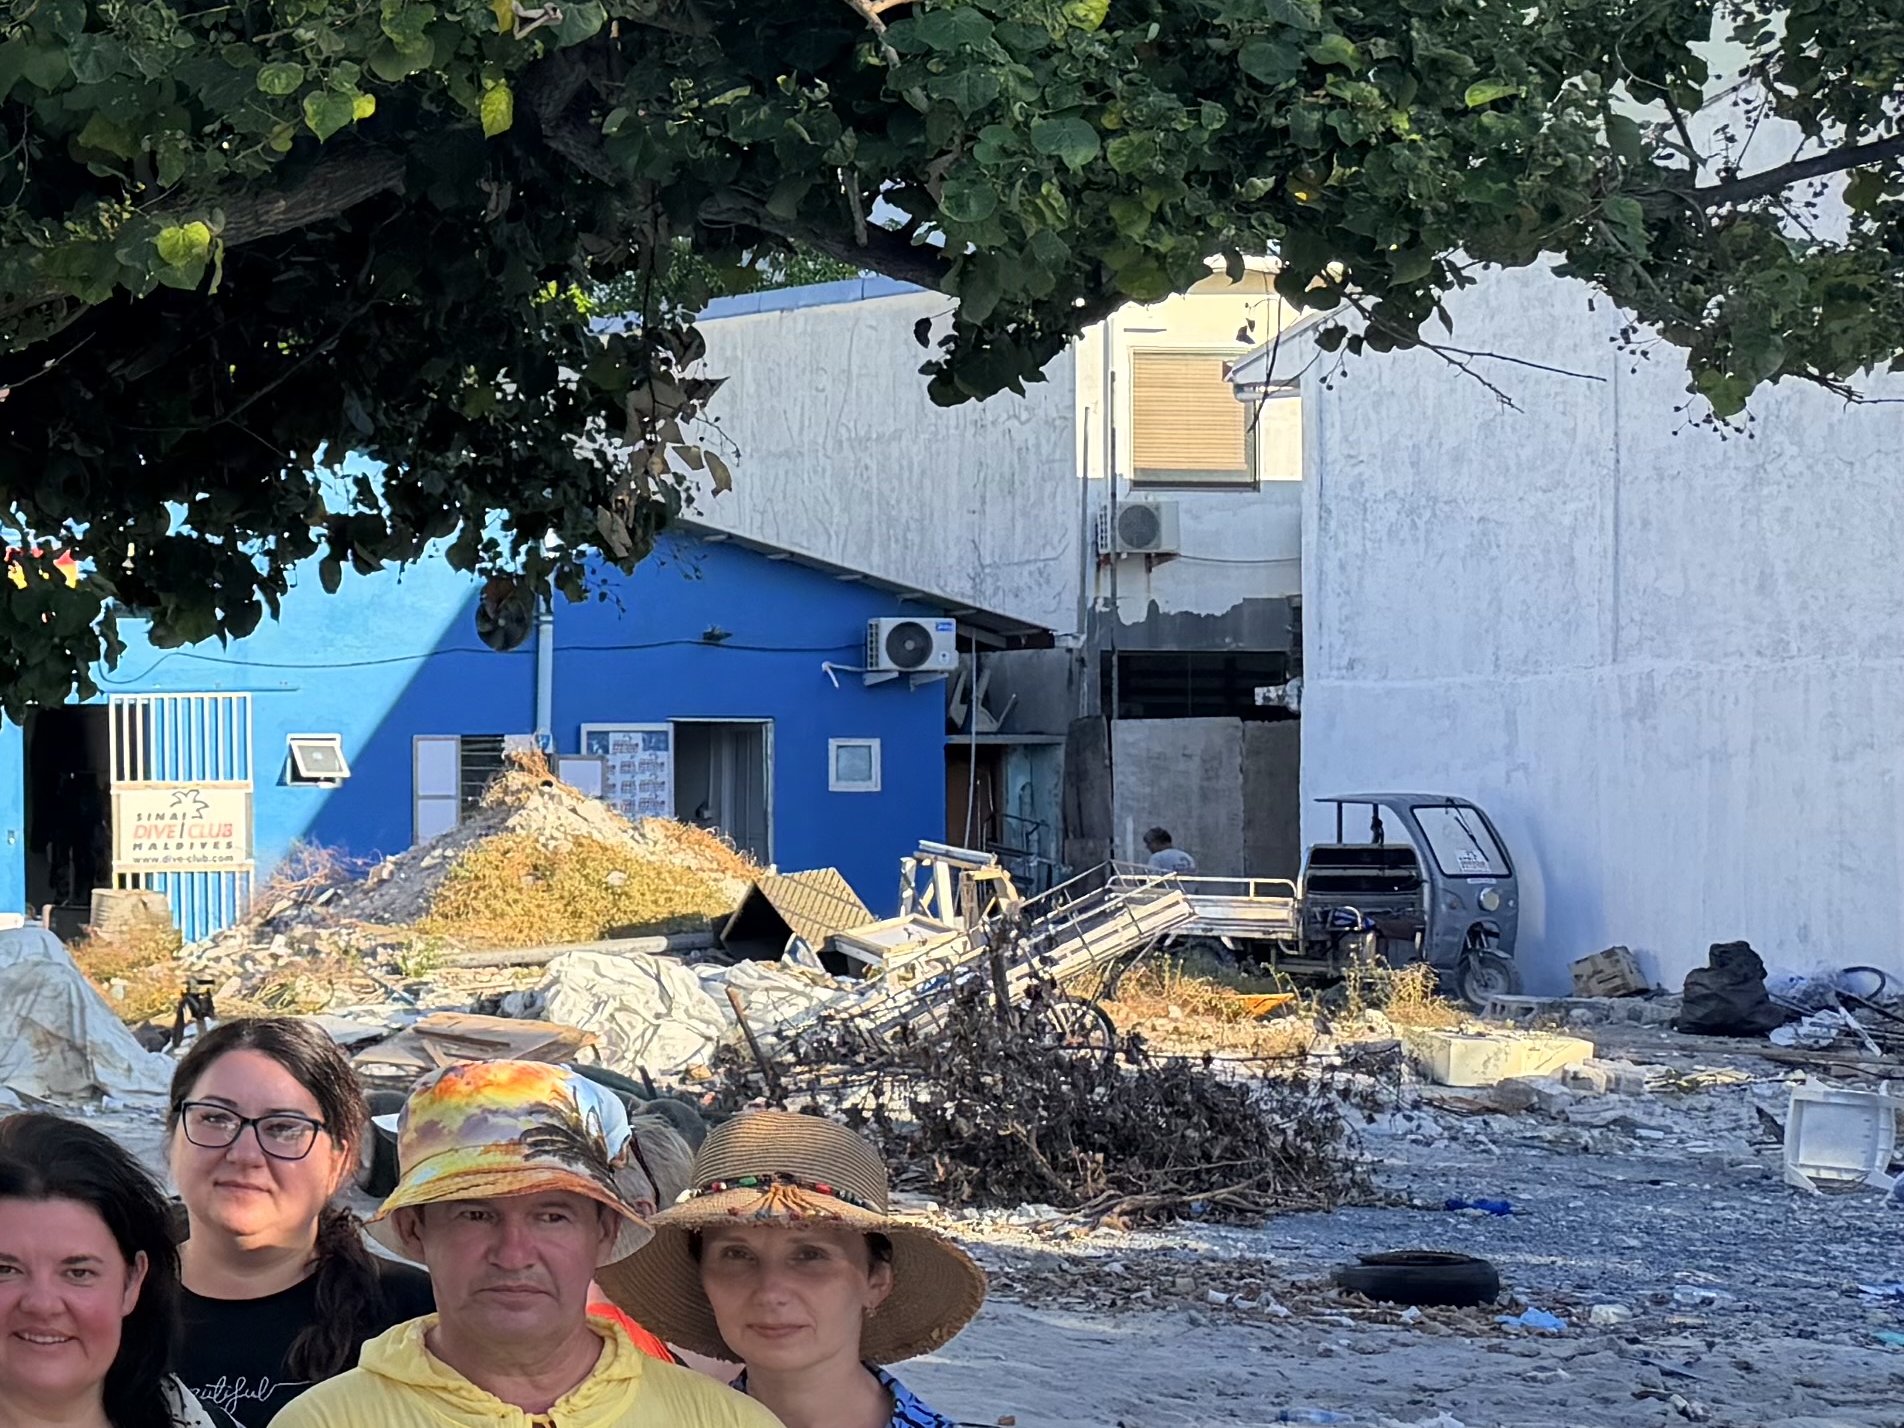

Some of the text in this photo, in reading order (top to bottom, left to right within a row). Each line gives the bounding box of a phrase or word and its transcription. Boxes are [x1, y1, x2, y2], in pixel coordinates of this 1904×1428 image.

[136, 812, 187, 822] SINAI
[132, 822, 234, 840] DIVE CLUB
[132, 841, 234, 851] MALDIVES
[132, 854, 235, 864] www.dive-club.com
